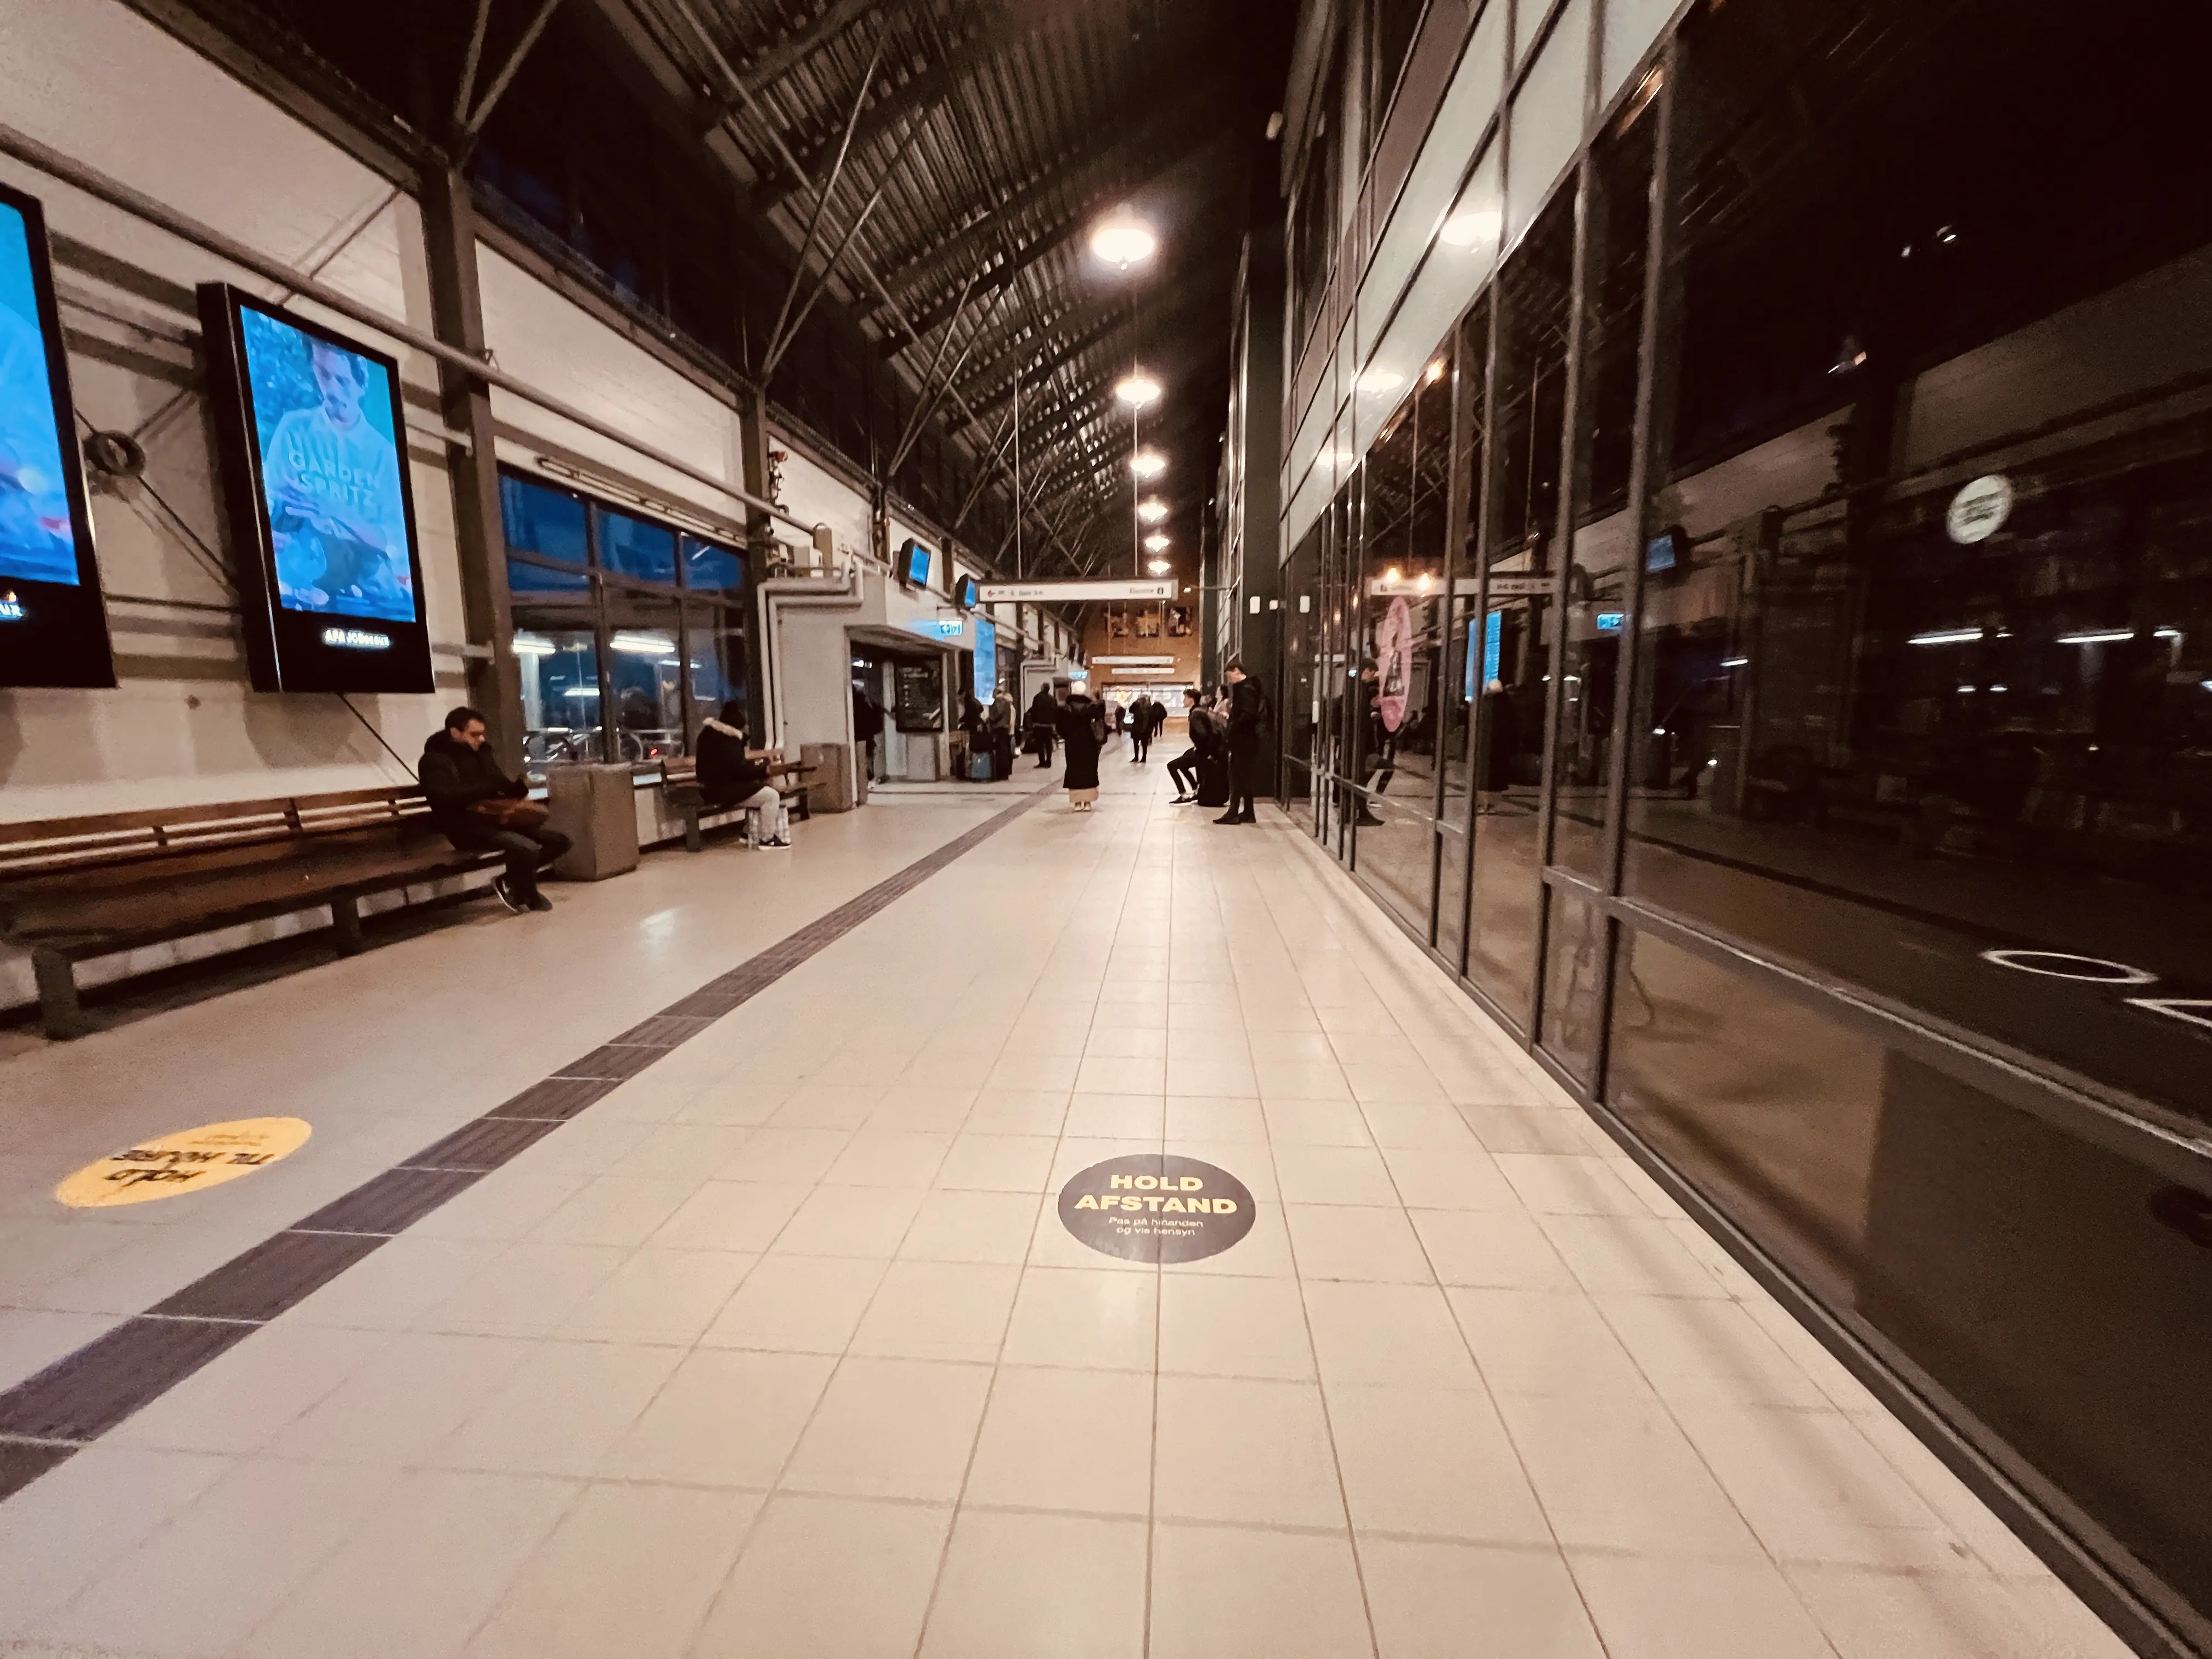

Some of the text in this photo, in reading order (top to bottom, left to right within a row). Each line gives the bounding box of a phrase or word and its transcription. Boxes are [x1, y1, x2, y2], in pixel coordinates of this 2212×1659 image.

[1110, 1175, 1203, 1191] HOLD
[1074, 1195, 1238, 1214] AFSTAND
[1109, 1216, 1203, 1227] Pas på hinanden
[1116, 1227, 1131, 1235] og
[1154, 1227, 1195, 1237] hensyn
